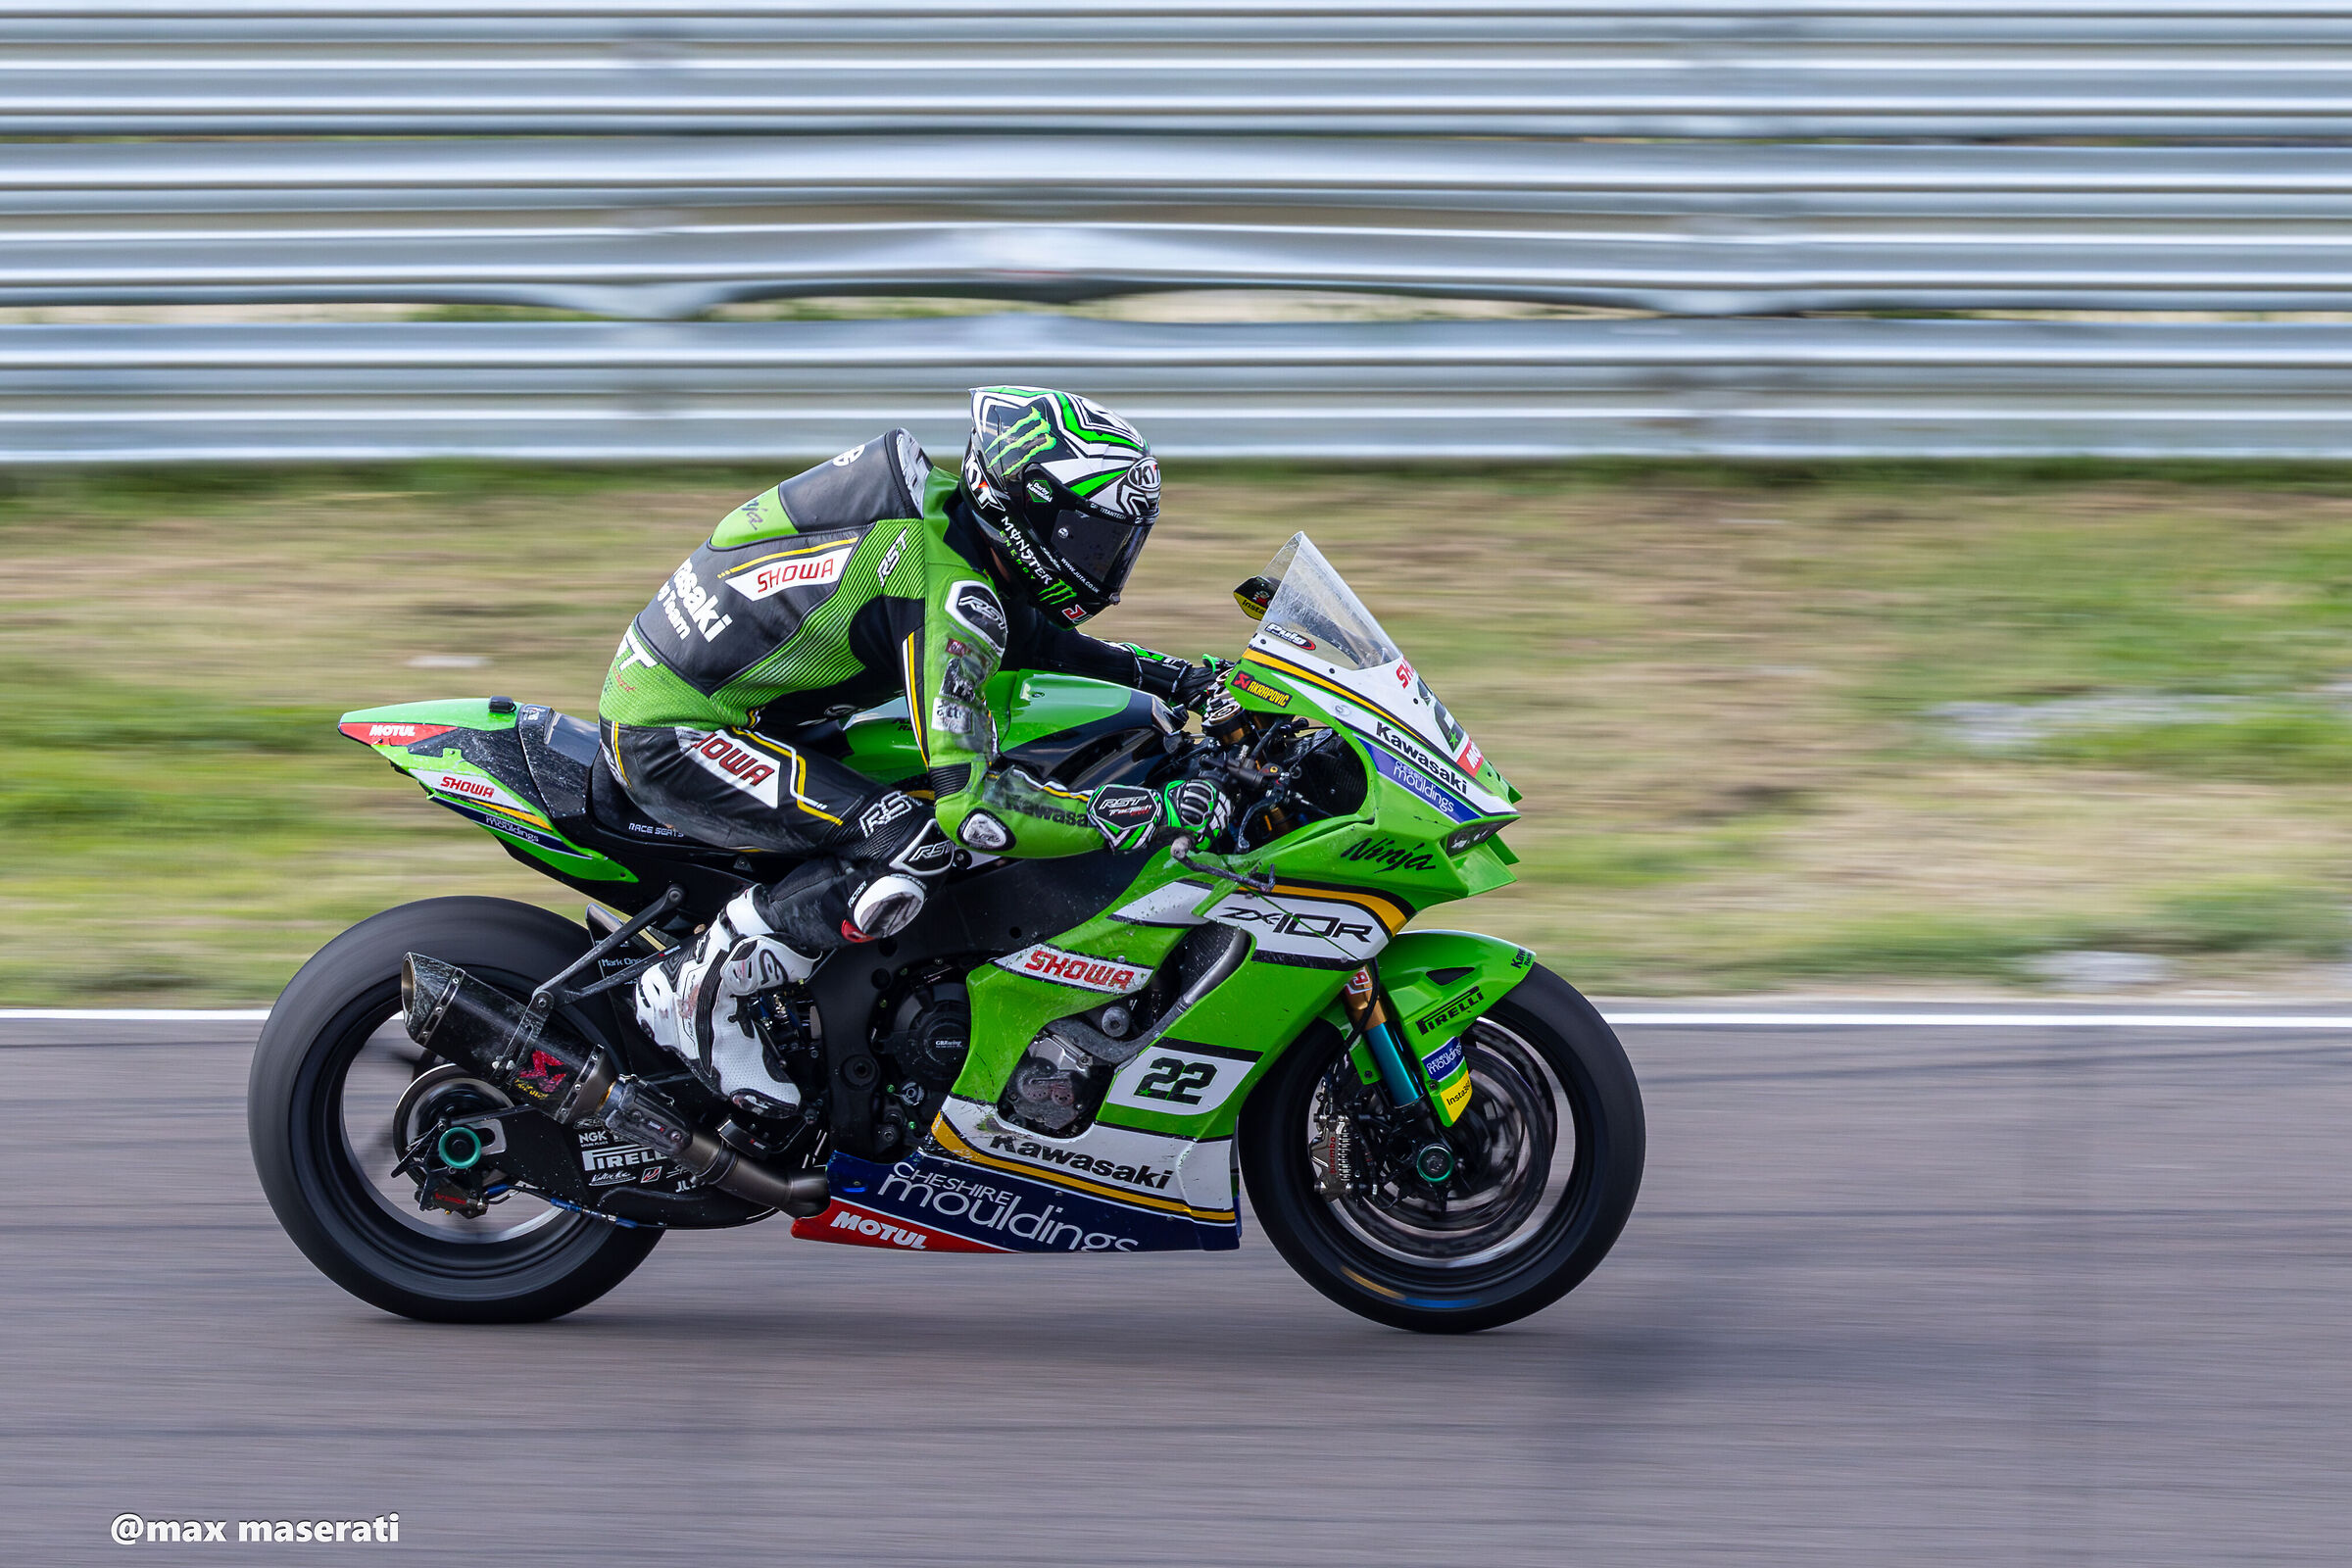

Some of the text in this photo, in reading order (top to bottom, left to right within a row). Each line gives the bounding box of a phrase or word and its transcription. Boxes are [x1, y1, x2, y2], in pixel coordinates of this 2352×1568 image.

[877, 527, 907, 588] RST
[999, 529, 1037, 580] ENERGY
[1000, 515, 1054, 586] MONSTER
[758, 558, 834, 594] SHOWA
[662, 589, 691, 641] Team
[1241, 599, 1266, 615] Insta
[1267, 622, 1307, 646] Puig
[369, 724, 416, 737] MOTUL
[1375, 721, 1468, 796] Kawasaki
[441, 776, 495, 799] SHOWA
[1098, 795, 1149, 810] RST
[1393, 765, 1455, 813] mouldings
[628, 822, 654, 835] RACE
[1340, 837, 1437, 874] Ninja
[601, 958, 623, 967] Mark
[1024, 950, 1135, 992] SHOWA
[1416, 985, 1485, 1036] PIRELLI
[1133, 1056, 1218, 1105] 22
[578, 1130, 607, 1144] NGK
[581, 1144, 668, 1172] PIRELL
[989, 1135, 1173, 1190] Kawasaki
[893, 1161, 1013, 1206] CHESHIRE
[830, 1210, 927, 1250] MOTUL
[878, 1172, 1139, 1252] mouldings
